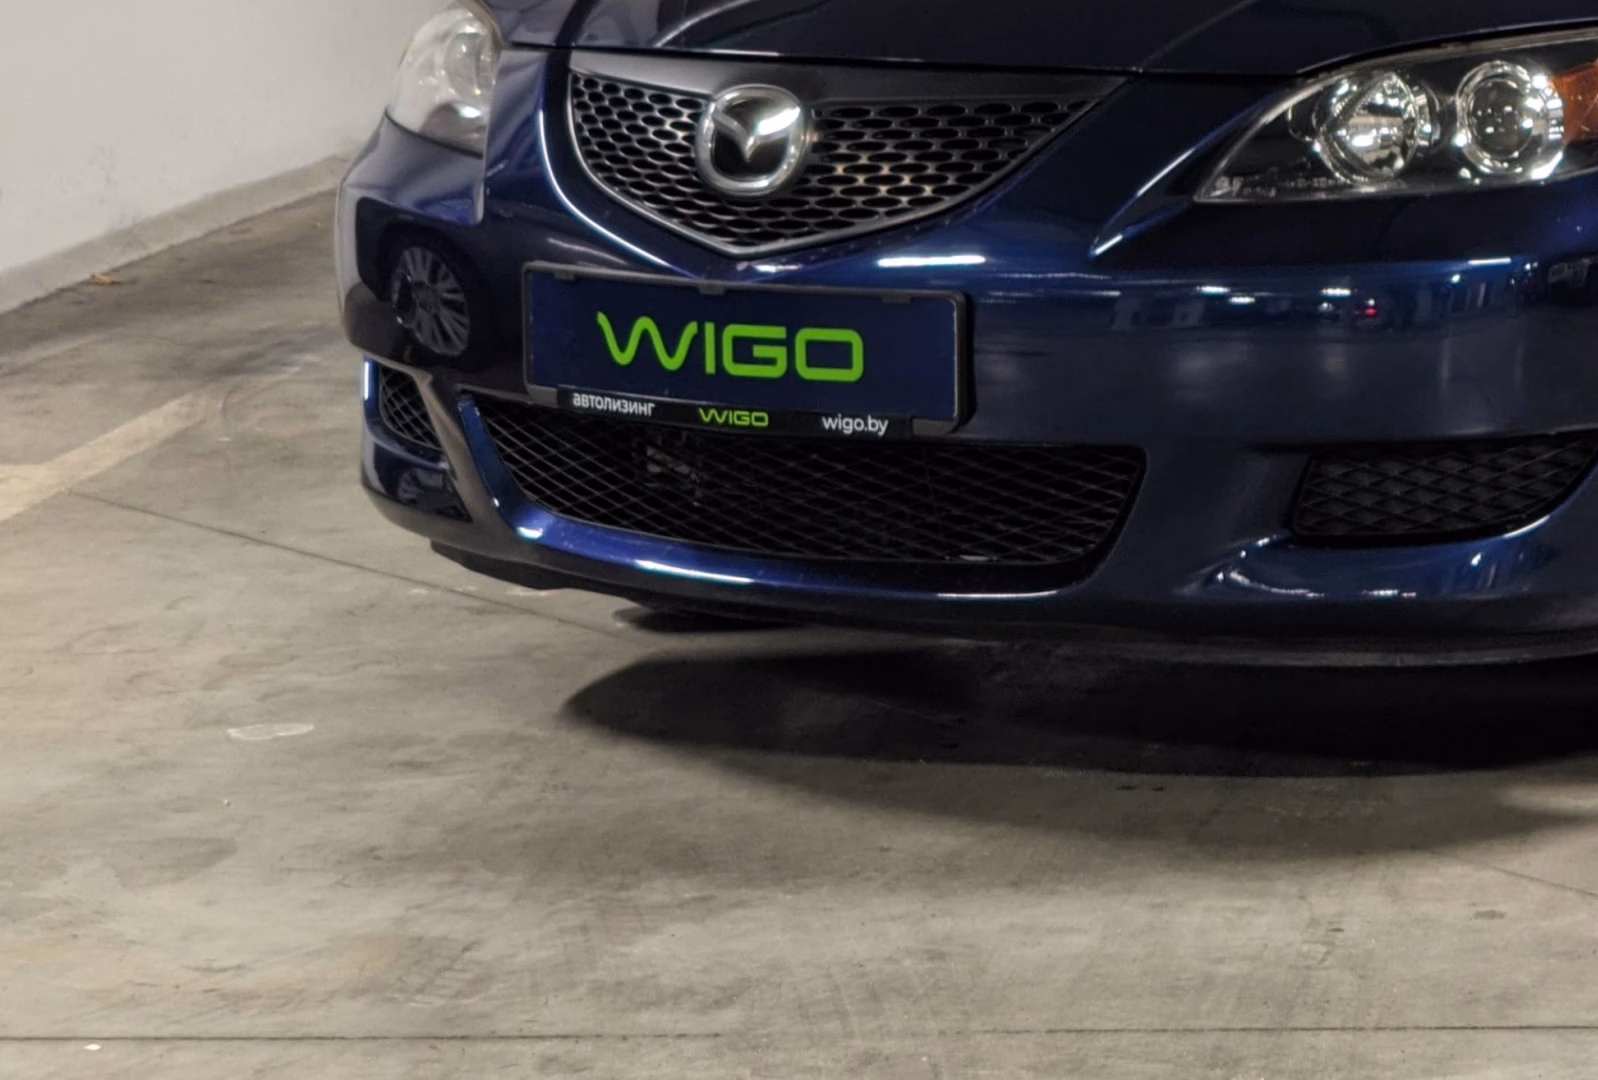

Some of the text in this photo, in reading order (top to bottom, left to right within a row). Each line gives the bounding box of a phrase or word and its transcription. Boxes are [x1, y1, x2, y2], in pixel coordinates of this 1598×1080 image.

[598, 311, 864, 382] WIGO
[572, 392, 656, 417] автолизинг
[699, 408, 769, 427] WIGO
[822, 414, 889, 436] wigo.by
